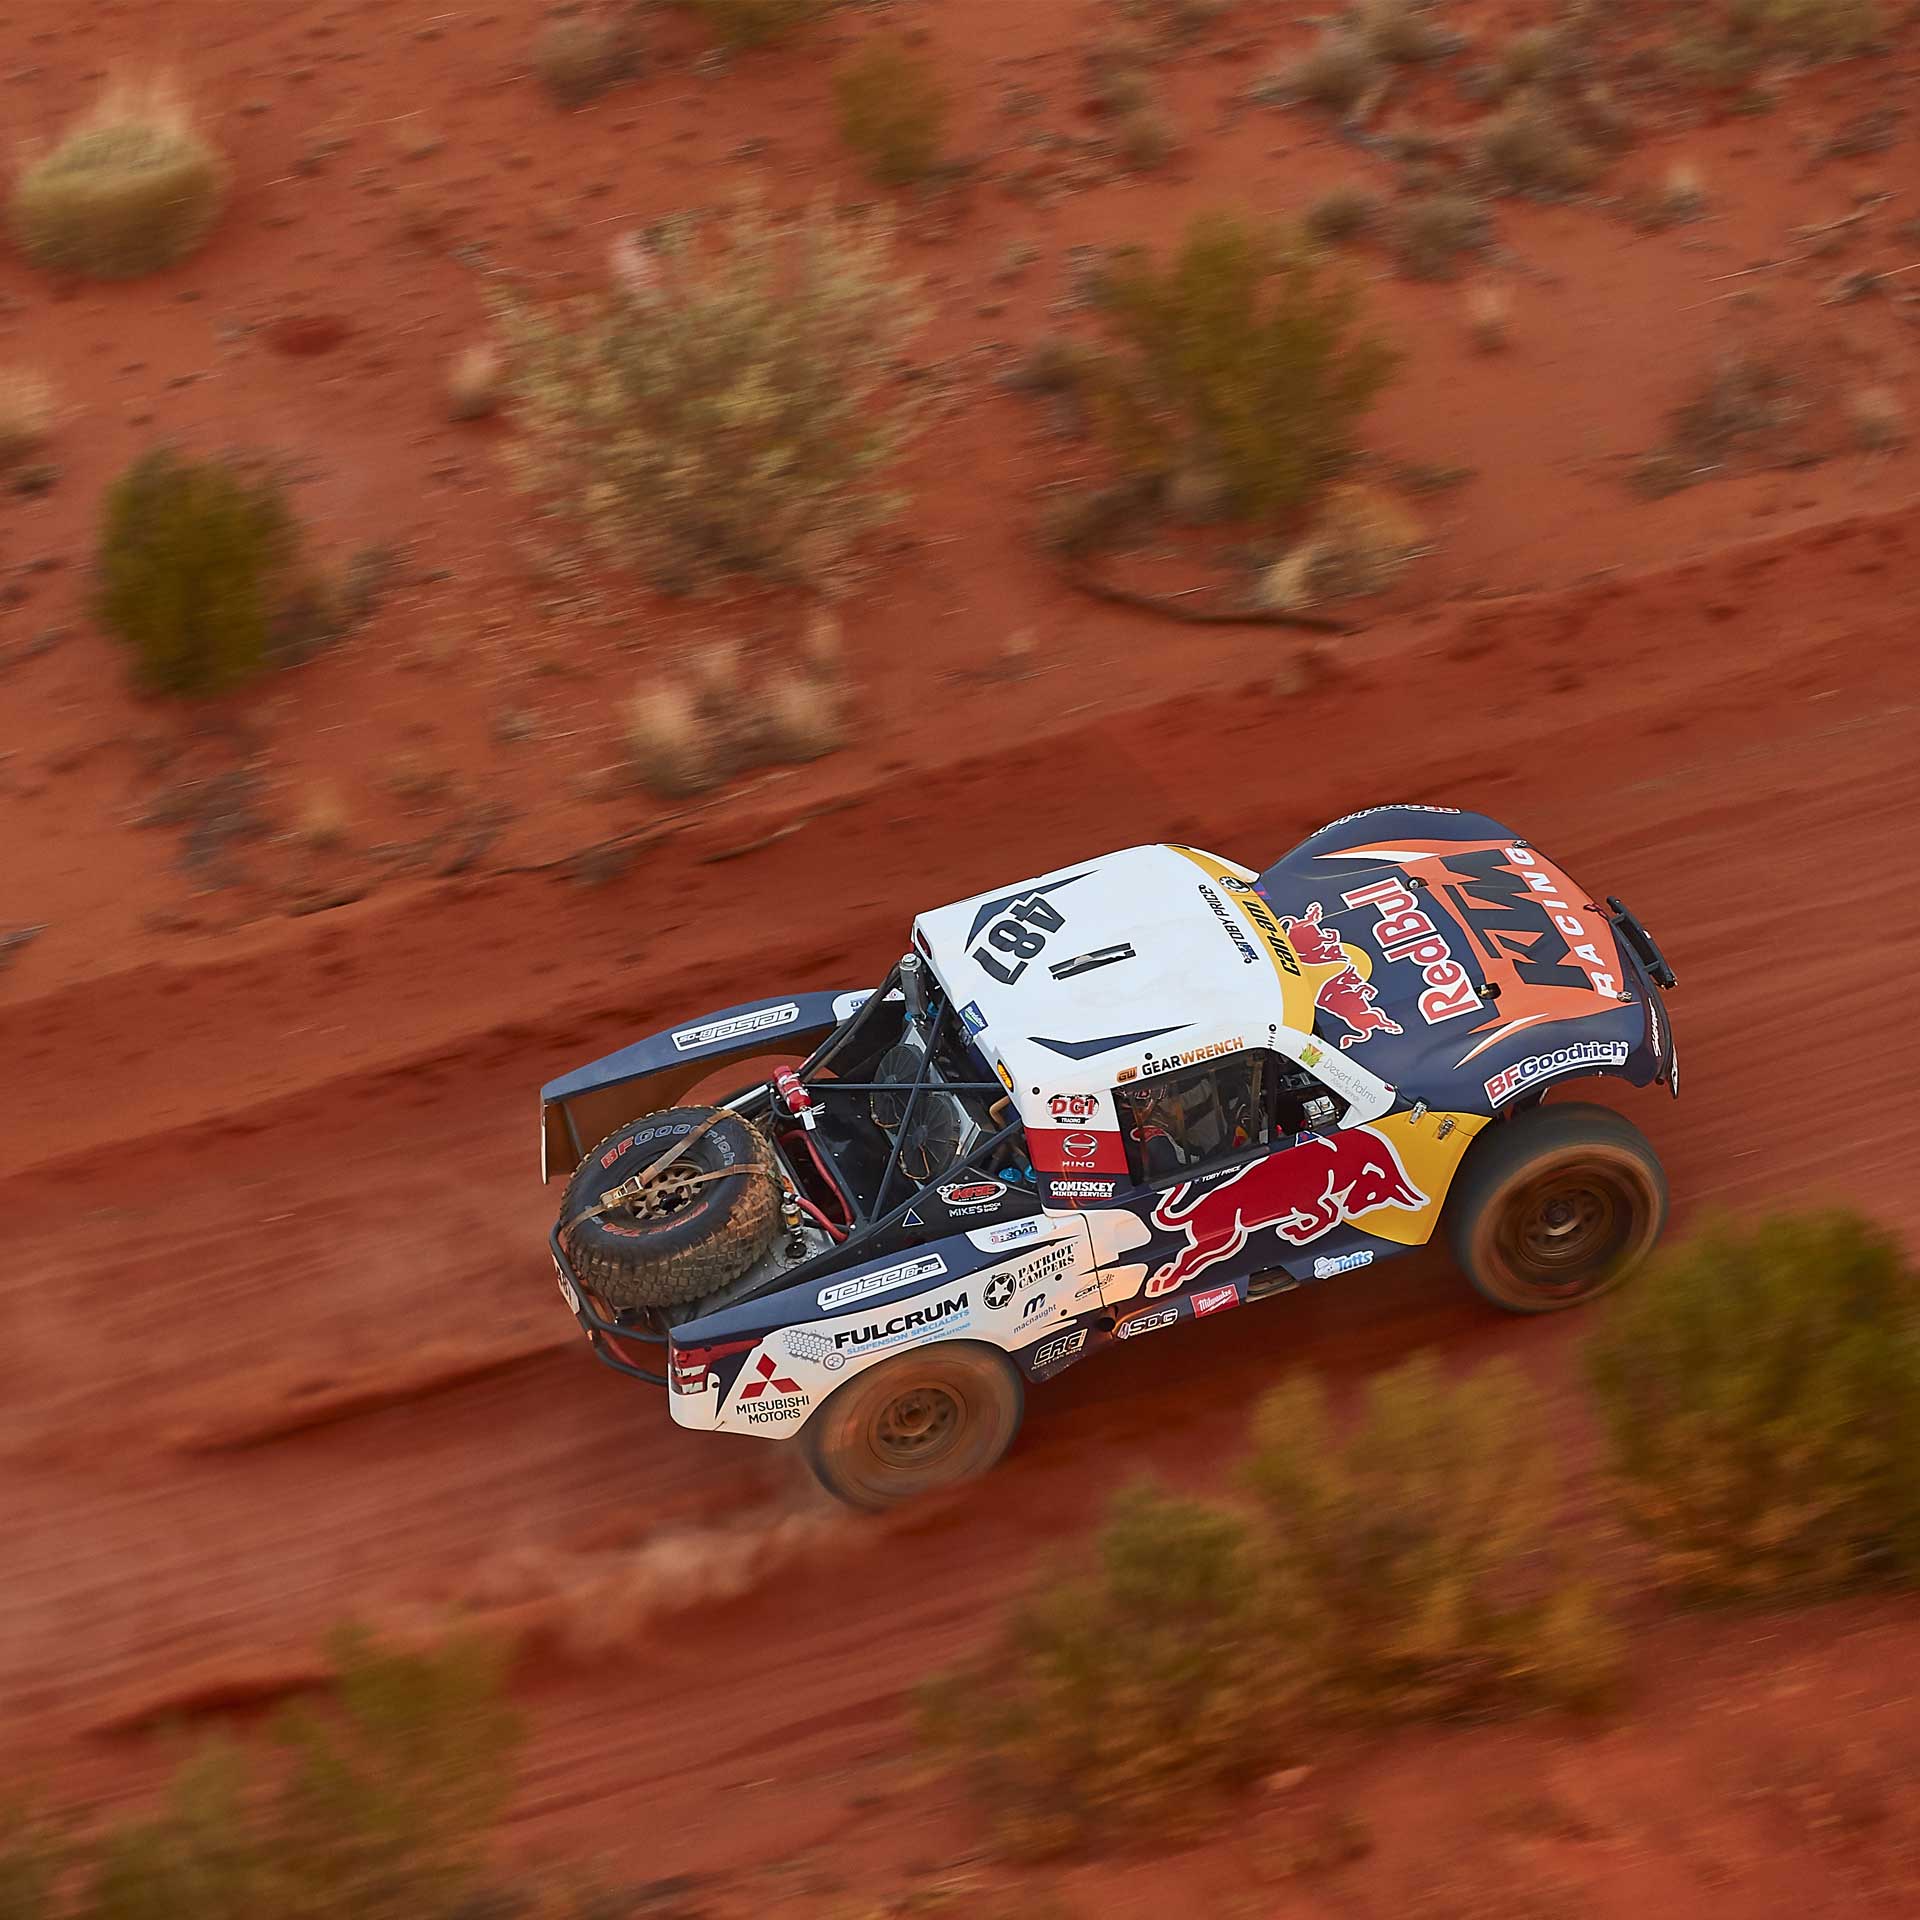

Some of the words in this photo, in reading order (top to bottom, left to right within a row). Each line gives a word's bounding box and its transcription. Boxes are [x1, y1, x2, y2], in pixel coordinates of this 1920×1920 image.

[1200, 886, 1229, 918] PRICE
[1218, 917, 1247, 949] TOBY
[1438, 848, 1596, 992] KTM
[1504, 847, 1619, 1000] RACING
[972, 896, 1066, 986] 487
[1241, 900, 1302, 977] can-am
[1142, 1037, 1244, 1076] GEARWRENCH
[1486, 1042, 1628, 1100] BFGoodrich
[1323, 1058, 1353, 1085] Desert
[1352, 1080, 1377, 1104] Palms
[1051, 1098, 1095, 1116] DGI
[1049, 1181, 1116, 1192] COMISKEY
[1202, 1171, 1221, 1182] TOBY
[949, 1205, 983, 1217] MIKE'S
[1018, 1255, 1075, 1289] CAMPERS
[1335, 1251, 1373, 1272] Tatts
[1198, 1289, 1233, 1312] Milwaukee
[834, 1292, 969, 1349] FULCRUM
[846, 1332, 909, 1355] SUSPENSION
[911, 1309, 970, 1337] SPECIALISTS
[1013, 1304, 1057, 1334] macnaught
[1130, 1309, 1177, 1333] SDG
[736, 1395, 810, 1415] MITSUBISHI
[748, 1408, 801, 1425] MOTORS
